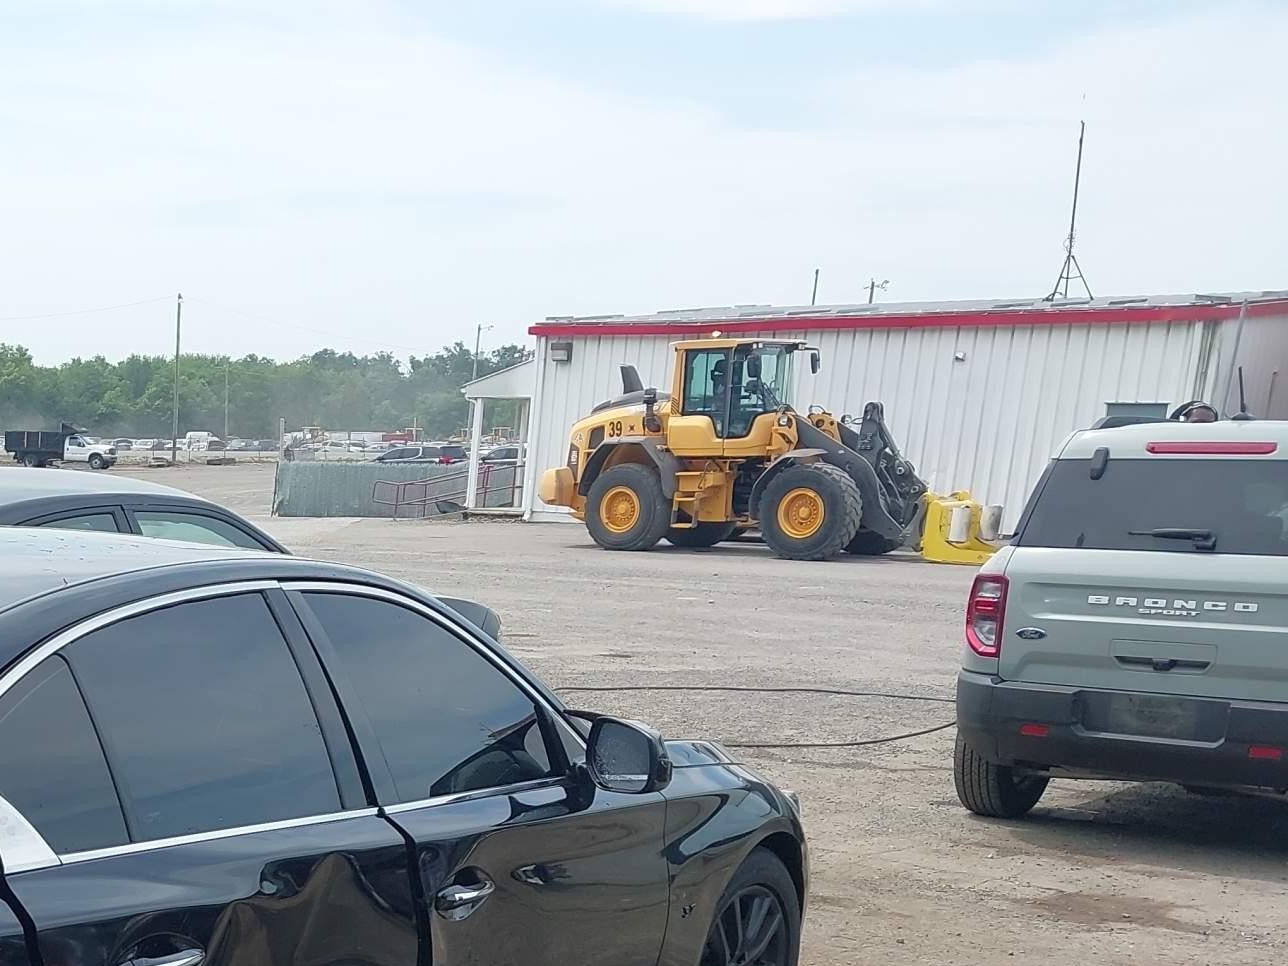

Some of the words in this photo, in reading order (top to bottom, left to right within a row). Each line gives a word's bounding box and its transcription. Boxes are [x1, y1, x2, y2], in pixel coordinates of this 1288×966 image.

[608, 420, 623, 437] 39
[1087, 595, 1258, 612] BRONCO
[1138, 608, 1201, 617] SPORT
